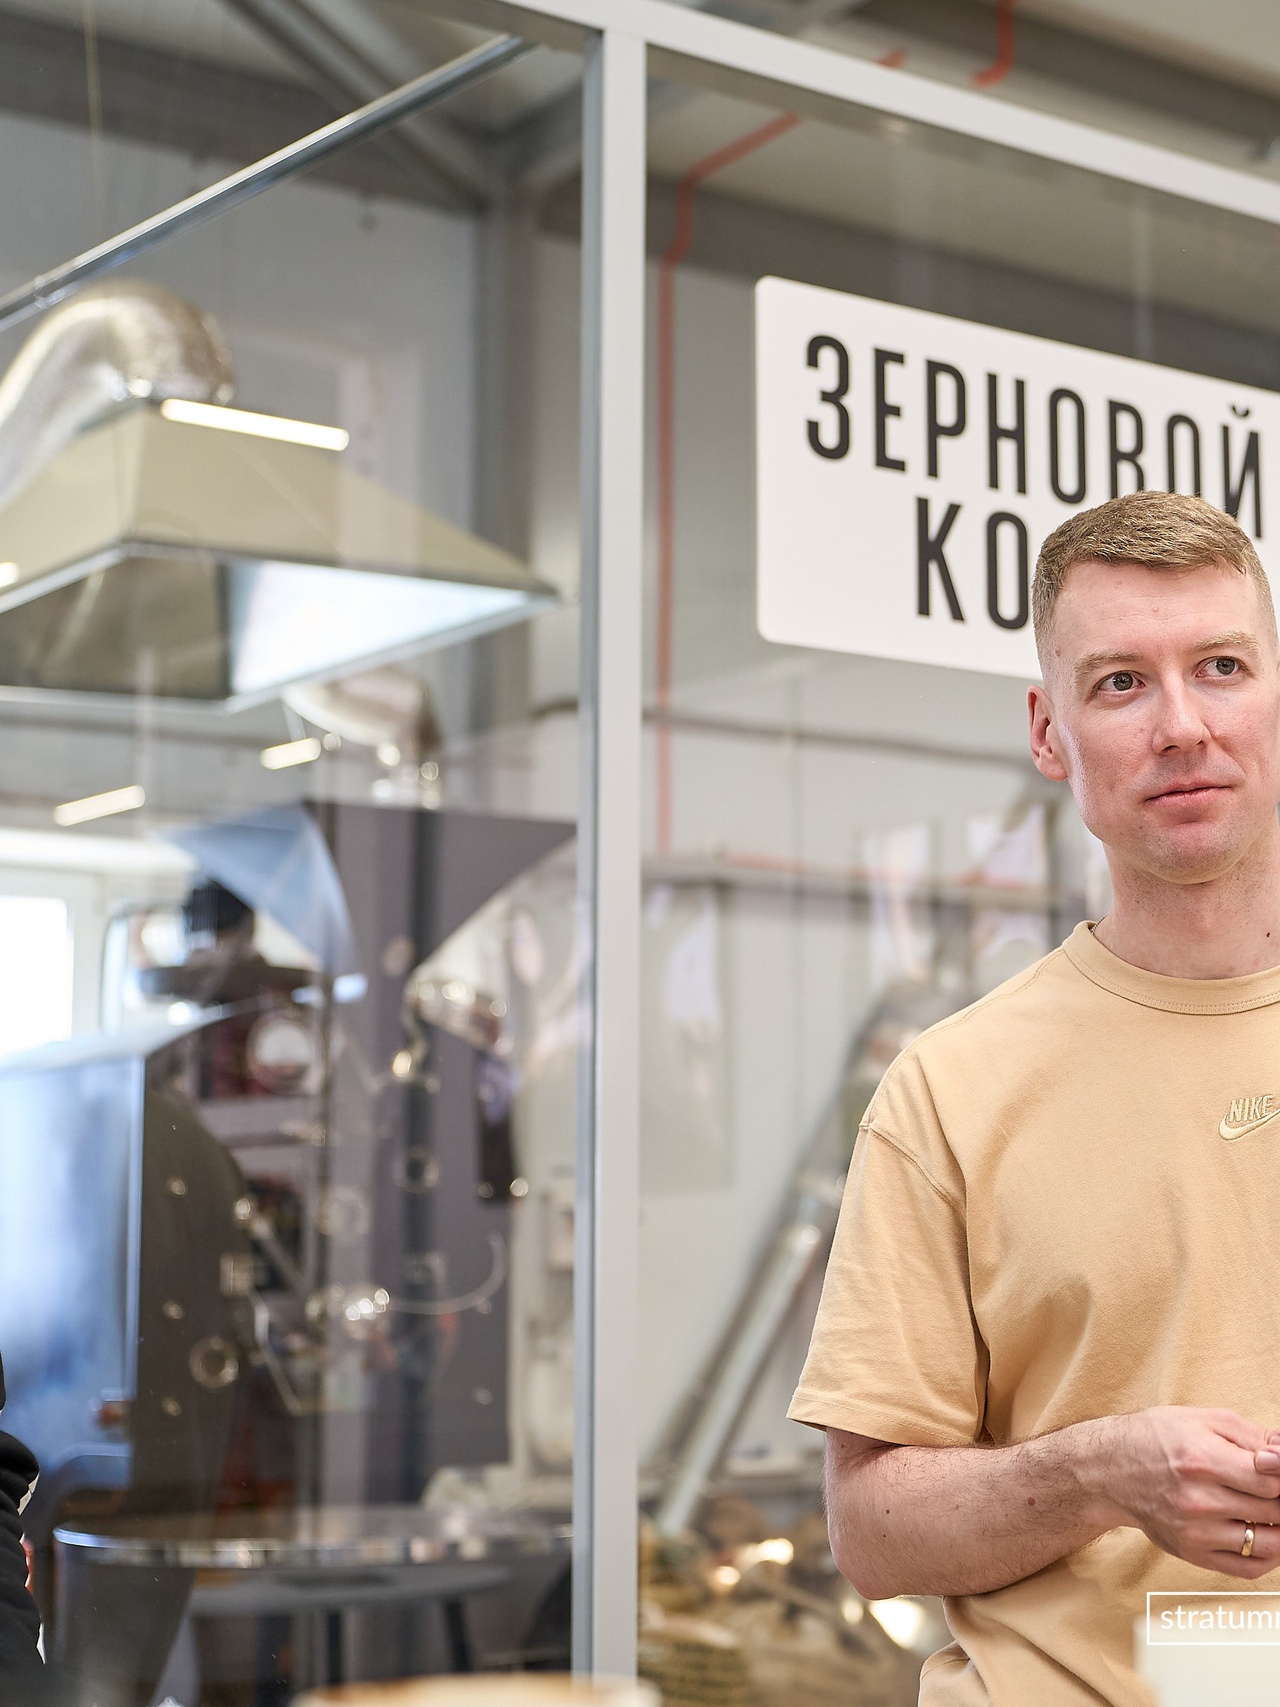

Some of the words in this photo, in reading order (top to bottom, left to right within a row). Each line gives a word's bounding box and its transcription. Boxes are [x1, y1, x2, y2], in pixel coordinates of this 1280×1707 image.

[806, 335, 1263, 539] ЗЕРНОВОЙ
[916, 496, 1029, 631] КО
[1228, 1093, 1274, 1122] NIKE
